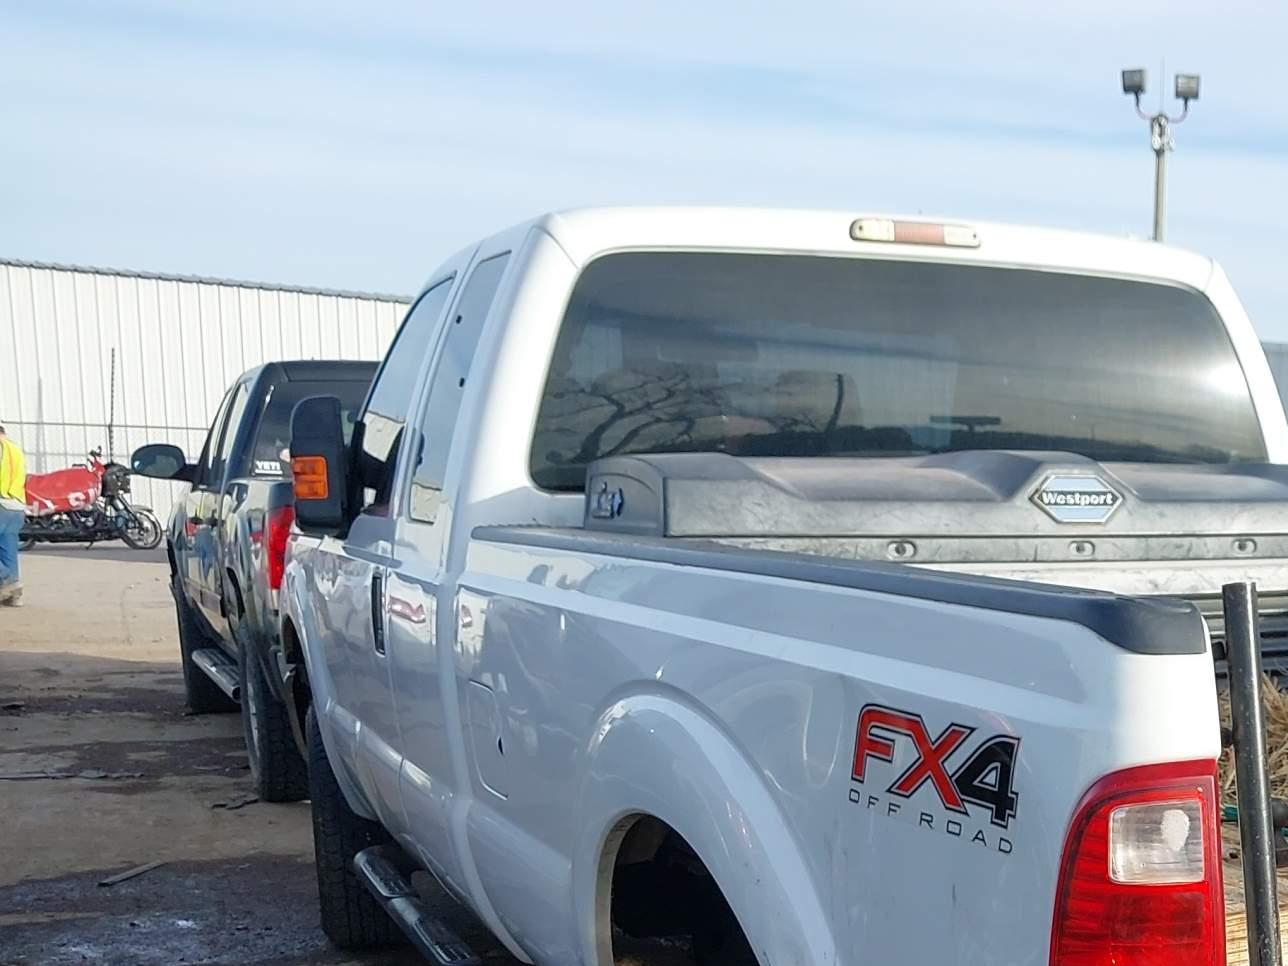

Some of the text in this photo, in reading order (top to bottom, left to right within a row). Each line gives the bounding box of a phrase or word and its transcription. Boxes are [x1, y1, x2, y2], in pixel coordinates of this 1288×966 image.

[255, 460, 281, 470] YETI
[1041, 492, 1113, 506] Westport
[851, 703, 1021, 830] FX4
[849, 788, 1014, 854] OFF ROAD
